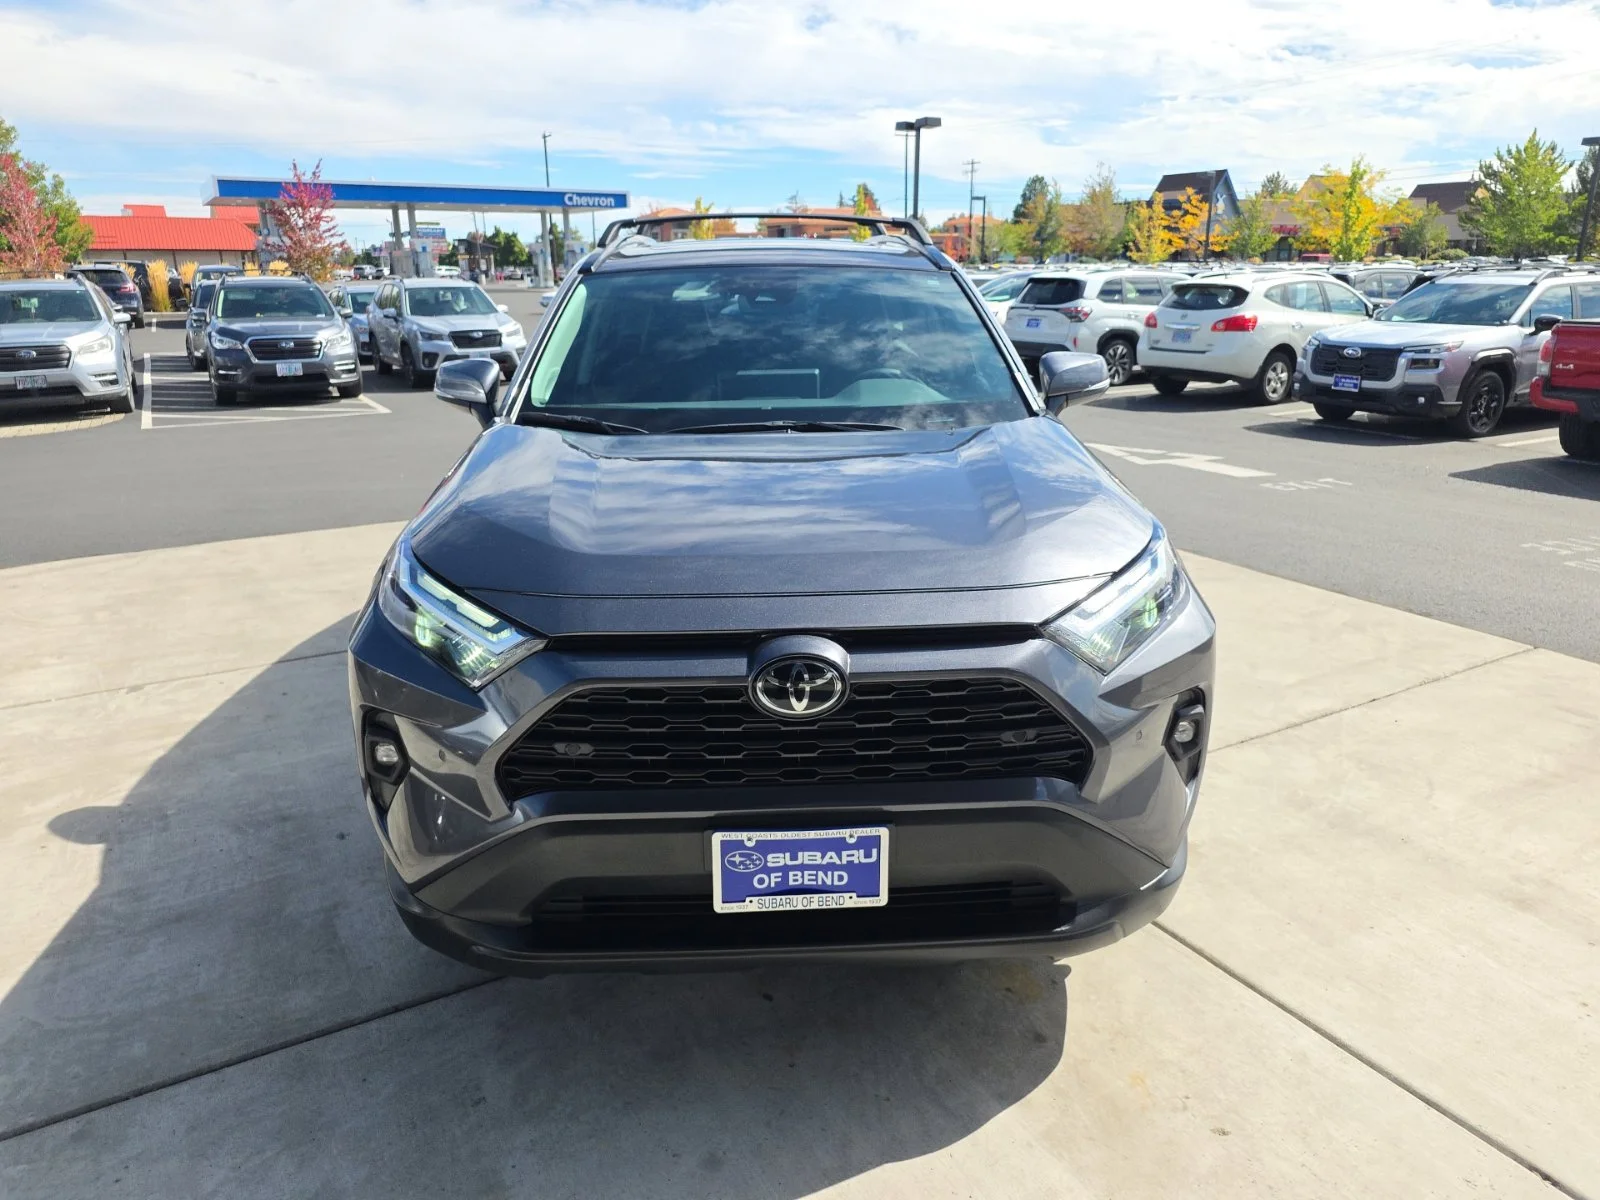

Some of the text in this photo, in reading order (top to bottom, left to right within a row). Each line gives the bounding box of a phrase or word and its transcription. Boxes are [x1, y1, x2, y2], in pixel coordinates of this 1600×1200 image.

[564, 193, 615, 207] Chevron
[813, 830, 847, 838] SUBARU
[849, 828, 881, 836] DEALER
[766, 848, 878, 868] SUBARU
[752, 871, 849, 889] OF BEND
[757, 895, 846, 910] SUBARU OF BEND
